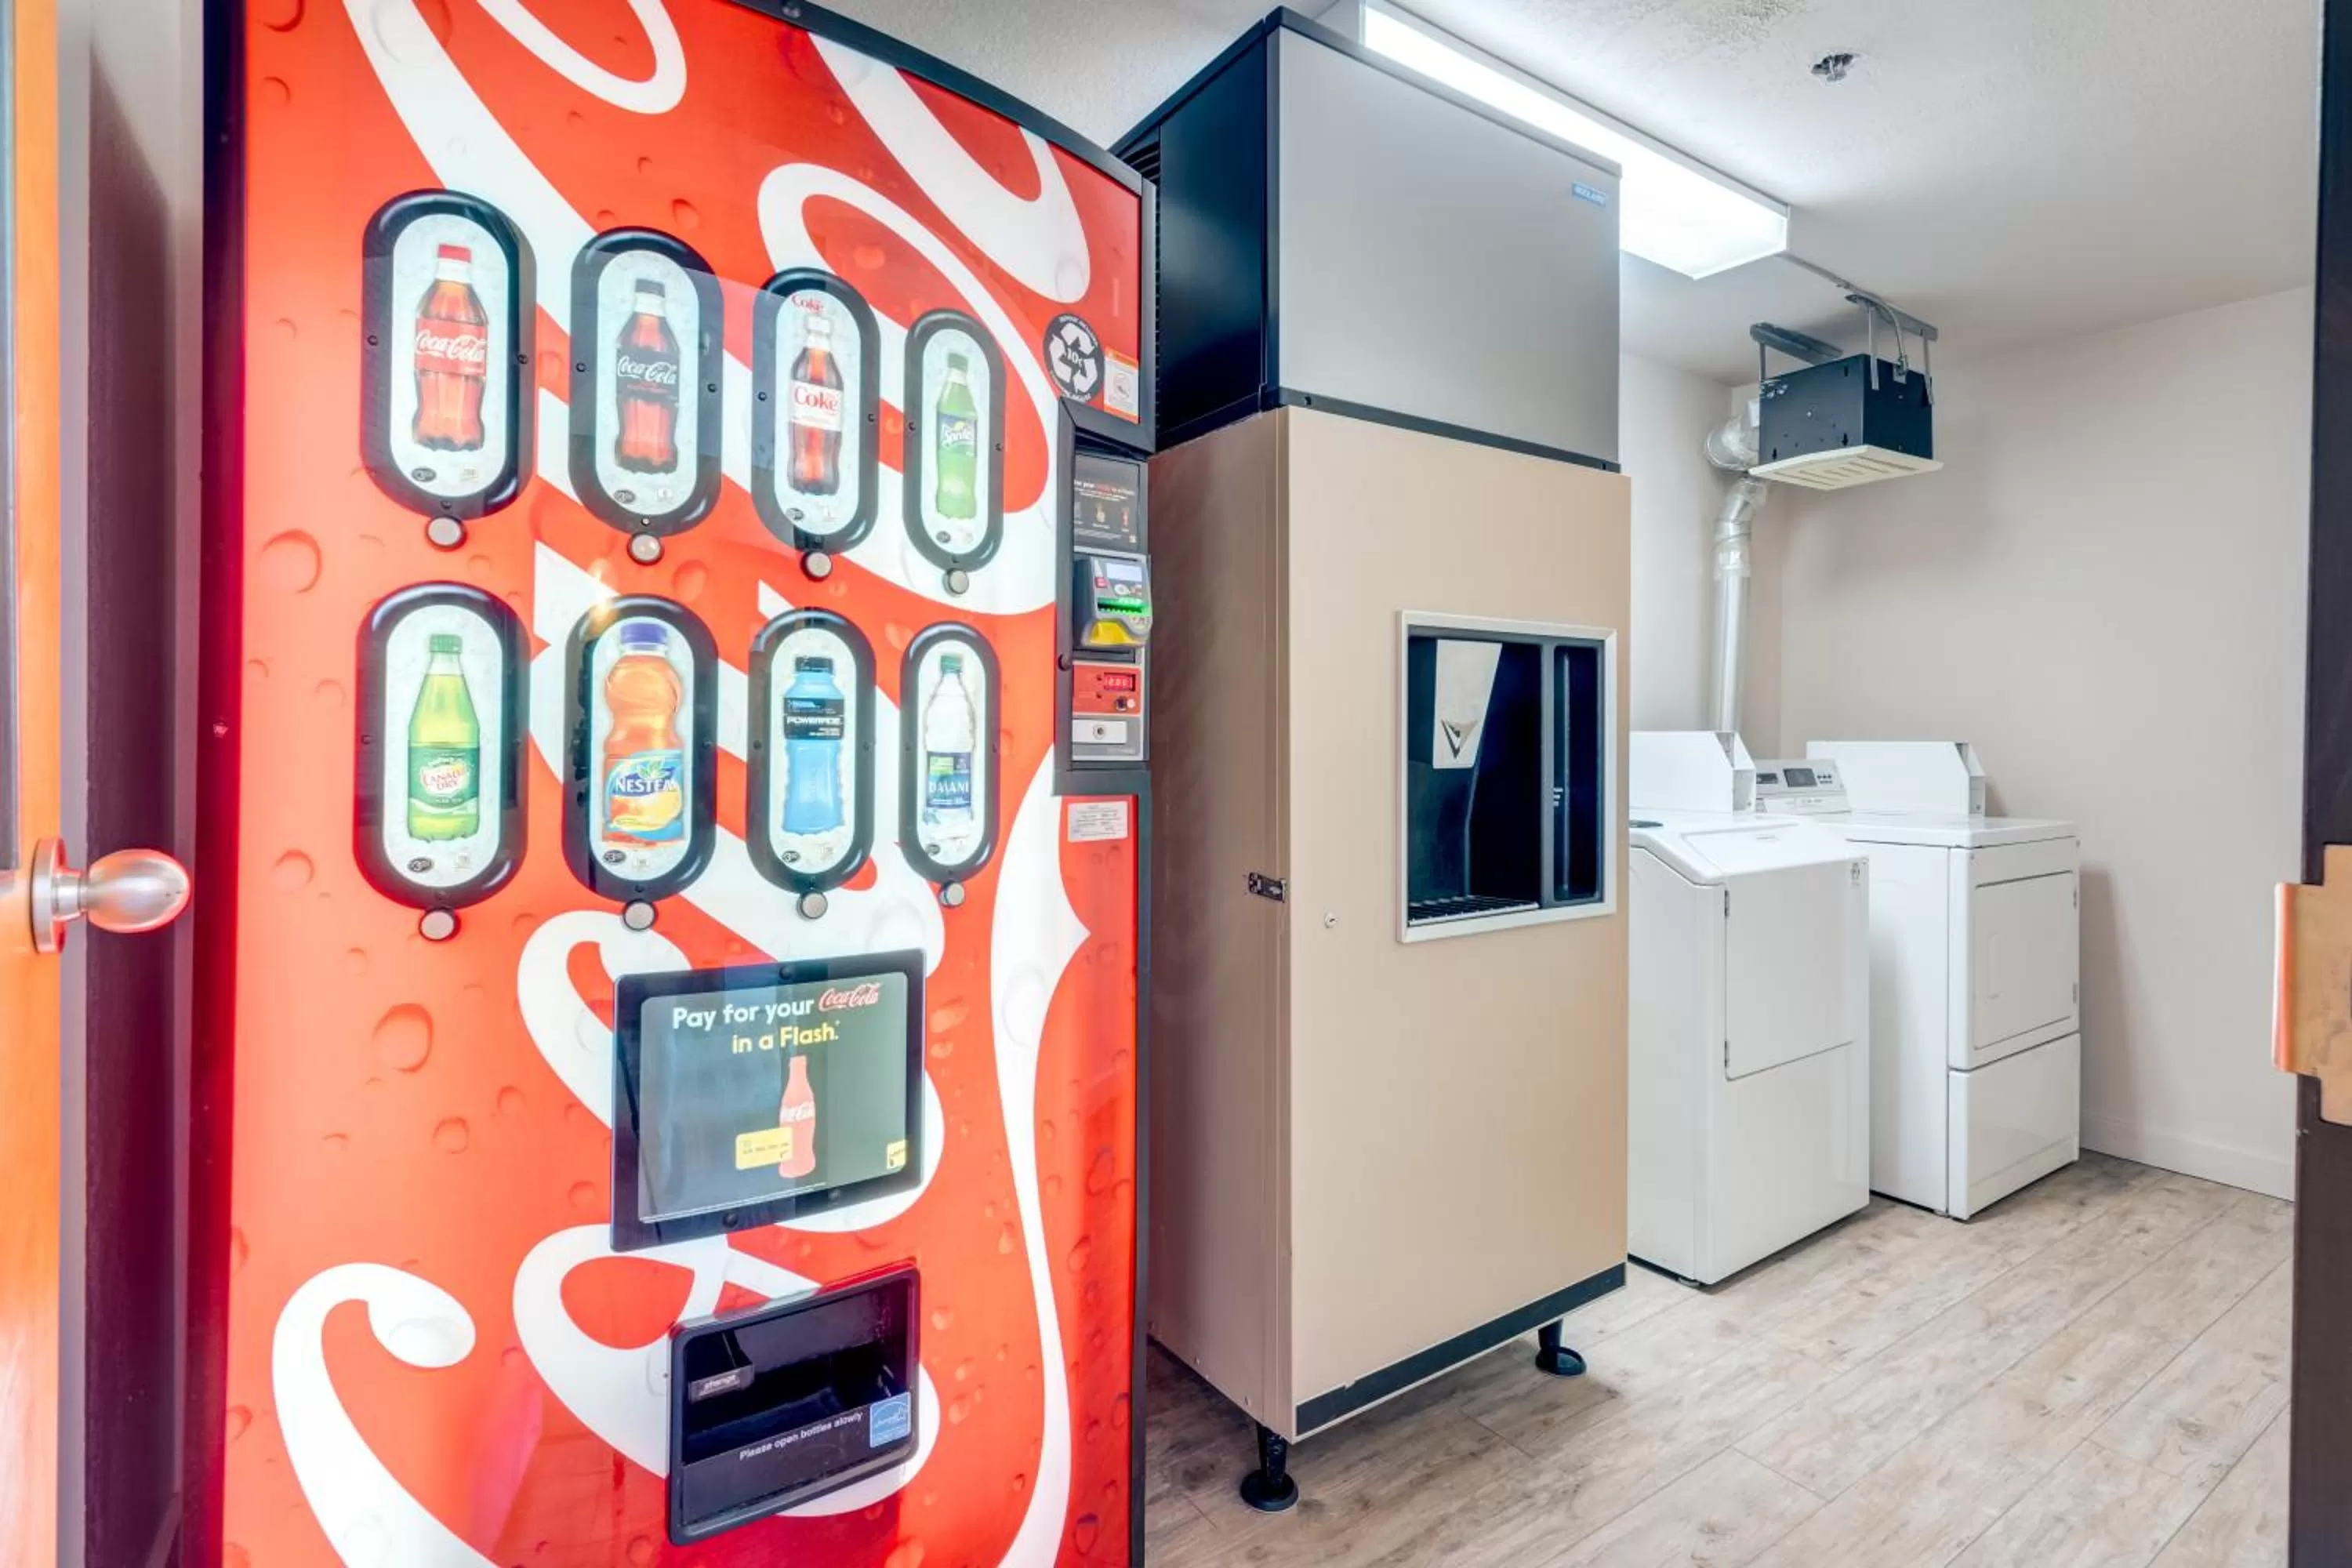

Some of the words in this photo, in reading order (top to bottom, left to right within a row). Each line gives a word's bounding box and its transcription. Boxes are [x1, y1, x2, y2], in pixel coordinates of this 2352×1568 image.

[617, 355, 677, 384] Coca-Cola
[794, 385, 838, 412] Coke
[614, 775, 674, 793] NESTEA
[673, 1007, 716, 1031] Pay
[723, 1003, 760, 1023] for
[764, 998, 815, 1024] your
[818, 982, 882, 1011] Coca-Cola
[731, 1034, 753, 1054] in
[758, 1034, 774, 1051] a
[739, 1441, 773, 1461] Please
[774, 1433, 799, 1450] open
[800, 1421, 833, 1440] bottles
[833, 1411, 864, 1429] slowly
